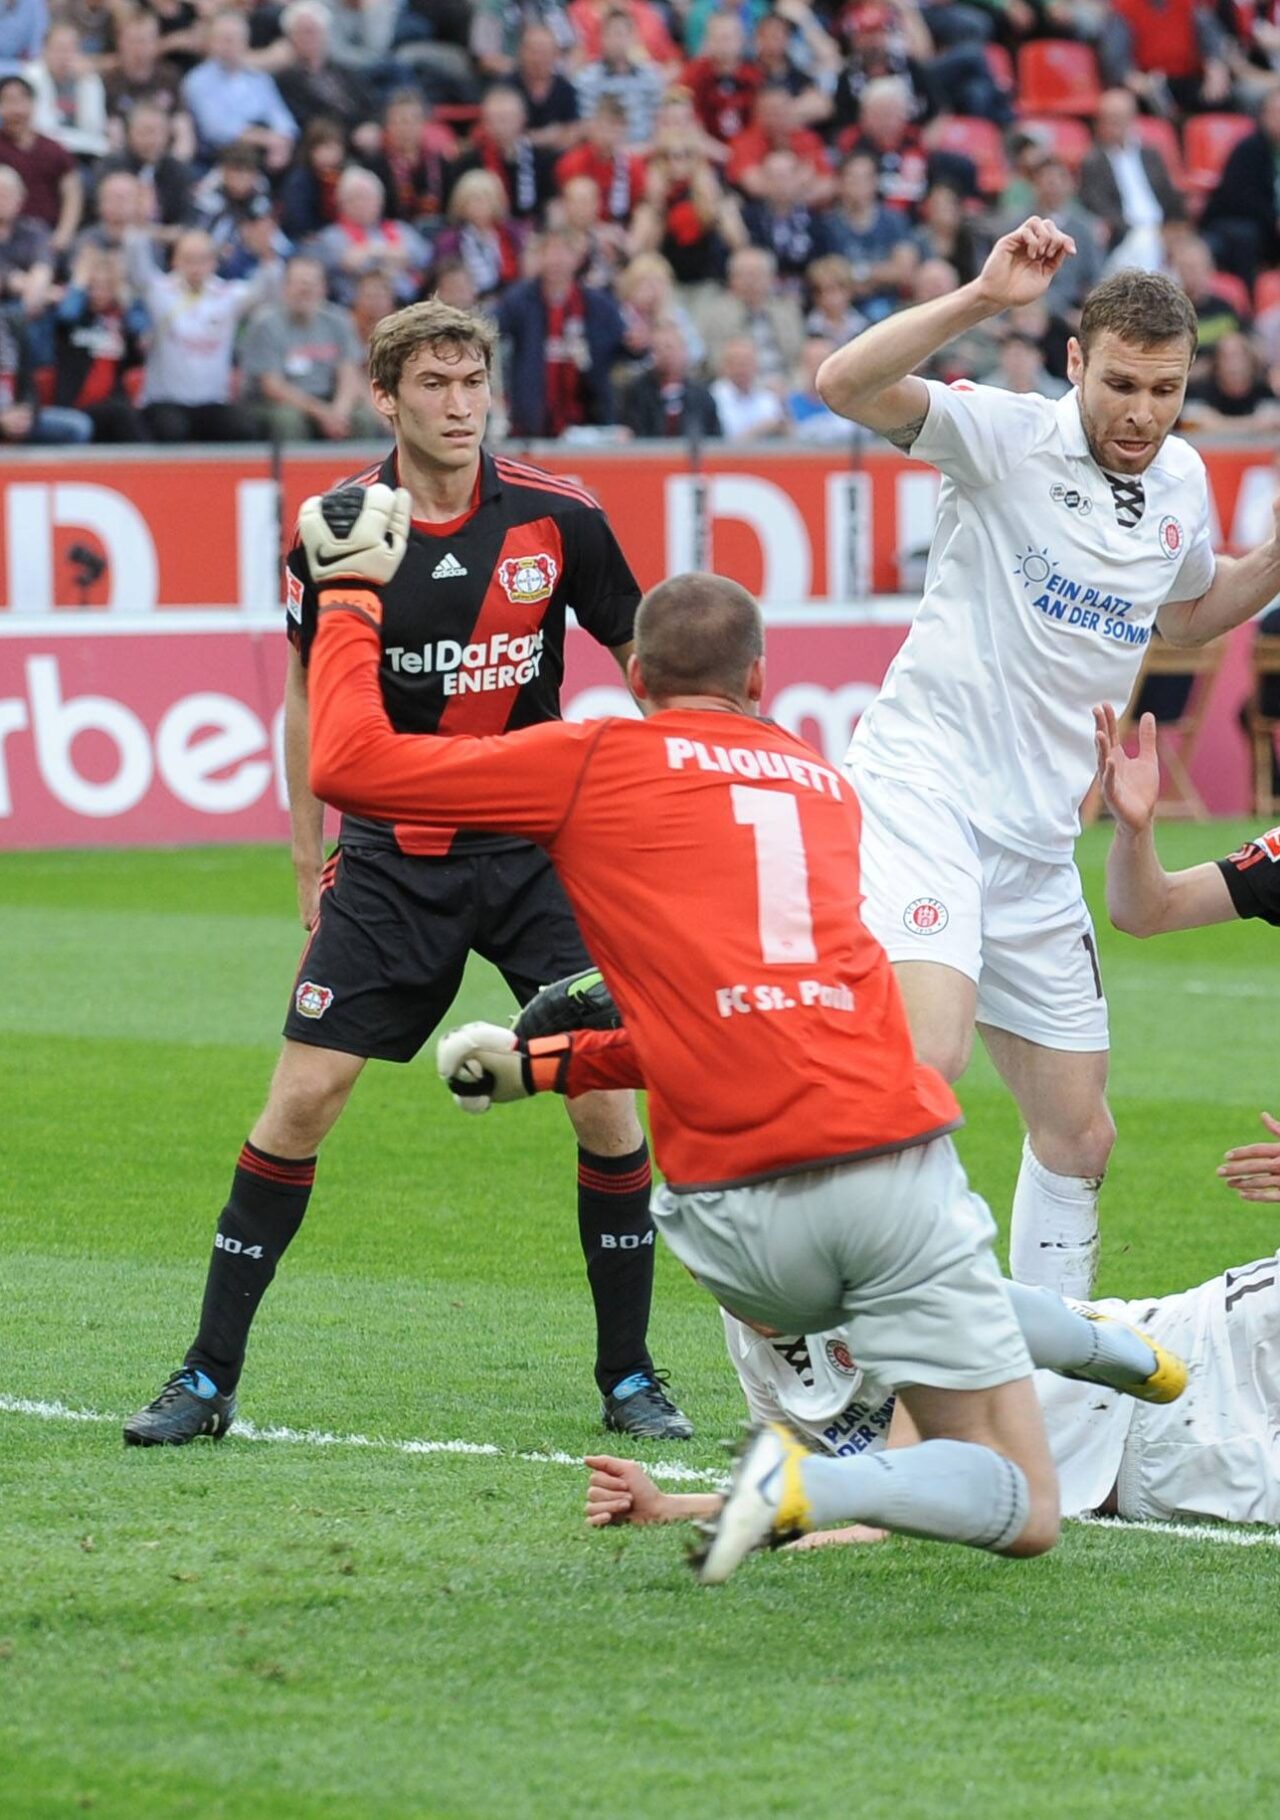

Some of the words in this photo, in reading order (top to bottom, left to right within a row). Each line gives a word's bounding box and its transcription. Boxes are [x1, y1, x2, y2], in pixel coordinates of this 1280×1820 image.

[1033, 594, 1069, 620] AN
[1068, 606, 1101, 632] DER
[1103, 617, 1151, 645] SONN
[1046, 574, 1082, 601] EIN
[1081, 588, 1133, 617] PLATZ
[443, 651, 543, 696] ENERGY
[664, 737, 843, 803] PLIQUETT
[729, 783, 818, 965] 1
[715, 984, 751, 1018] FC
[753, 985, 796, 1011] St.
